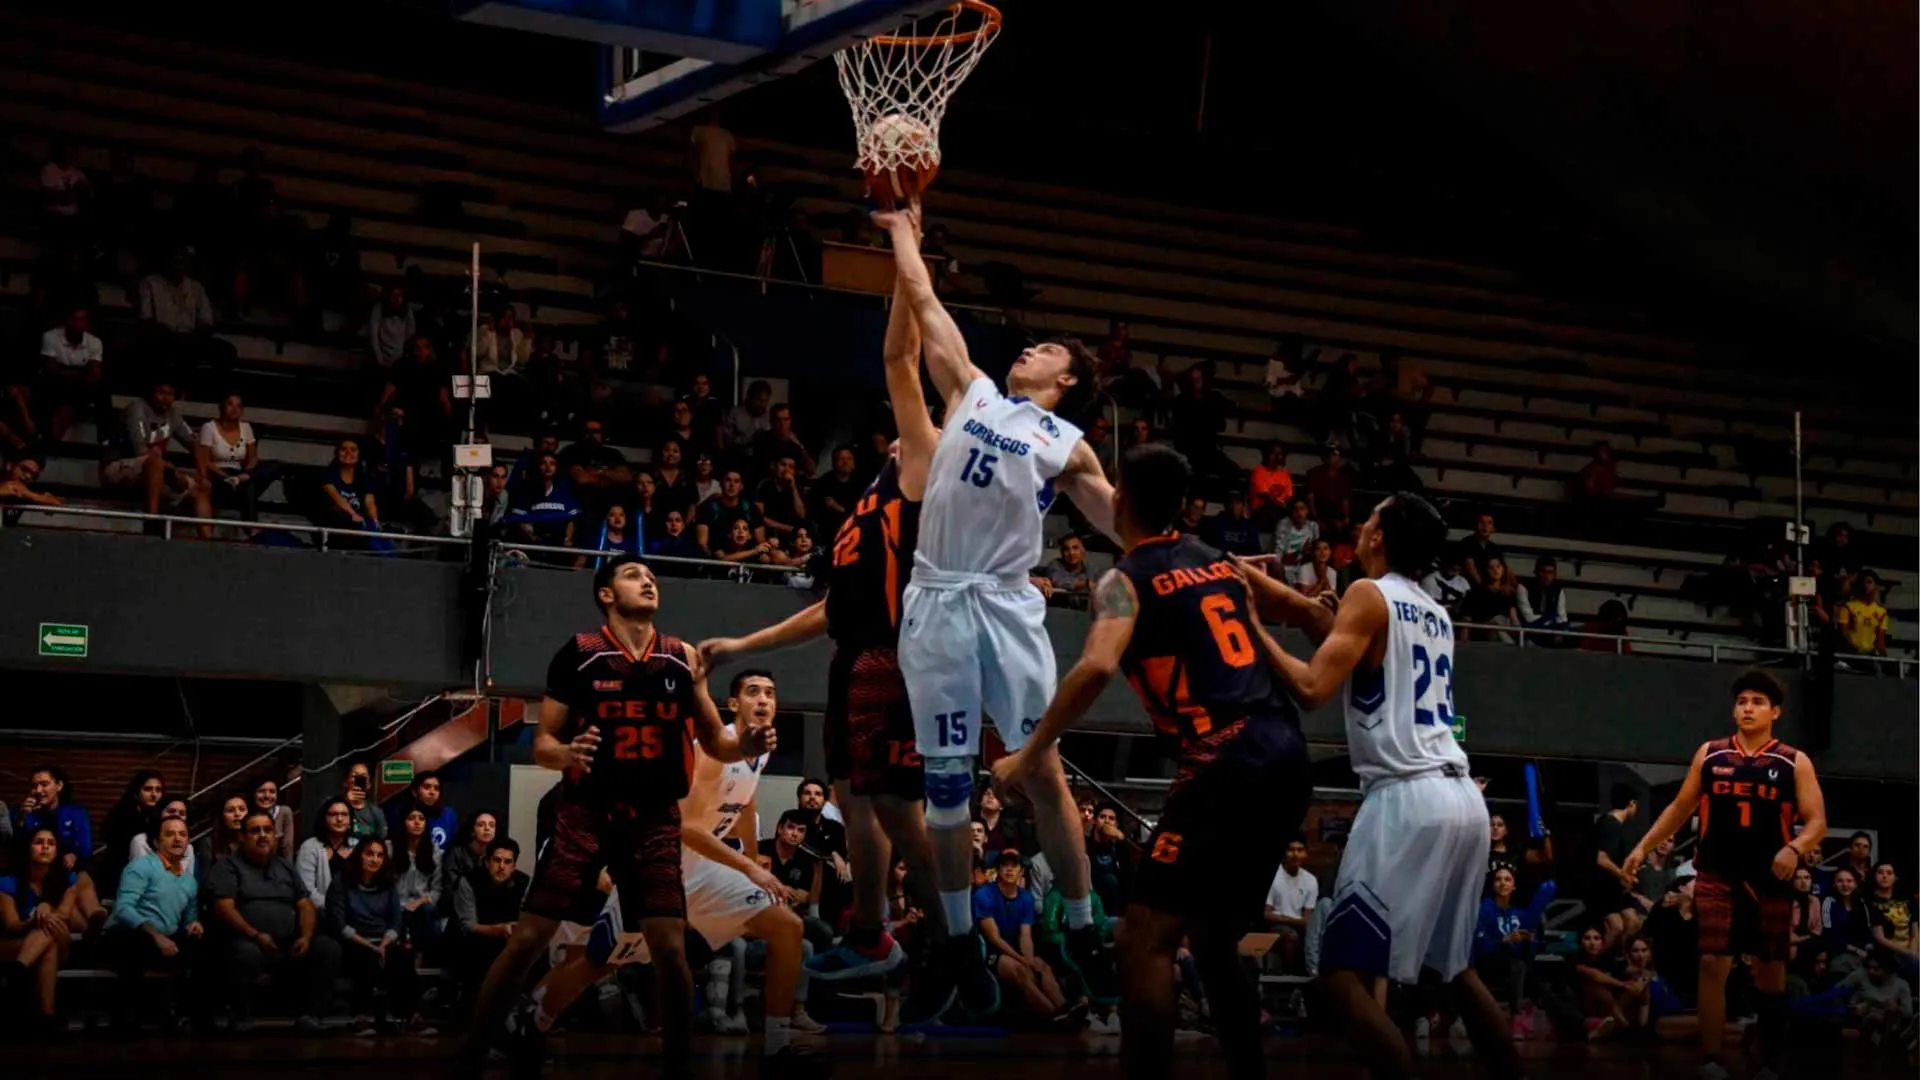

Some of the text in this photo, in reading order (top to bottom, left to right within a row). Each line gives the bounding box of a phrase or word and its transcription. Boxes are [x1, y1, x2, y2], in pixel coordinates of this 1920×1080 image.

[962, 418, 1031, 456] BORREGOS
[960, 448, 998, 488] 15
[1393, 600, 1418, 624] TEC
[1200, 592, 1256, 668] 6
[1412, 644, 1454, 726] 23
[597, 700, 678, 720] CEU
[614, 725, 663, 760] 25
[935, 711, 968, 746] 15
[887, 740, 922, 768] 12
[1712, 780, 1778, 801] CEU
[1737, 801, 1751, 828] 1
[1150, 831, 1184, 864] 6
